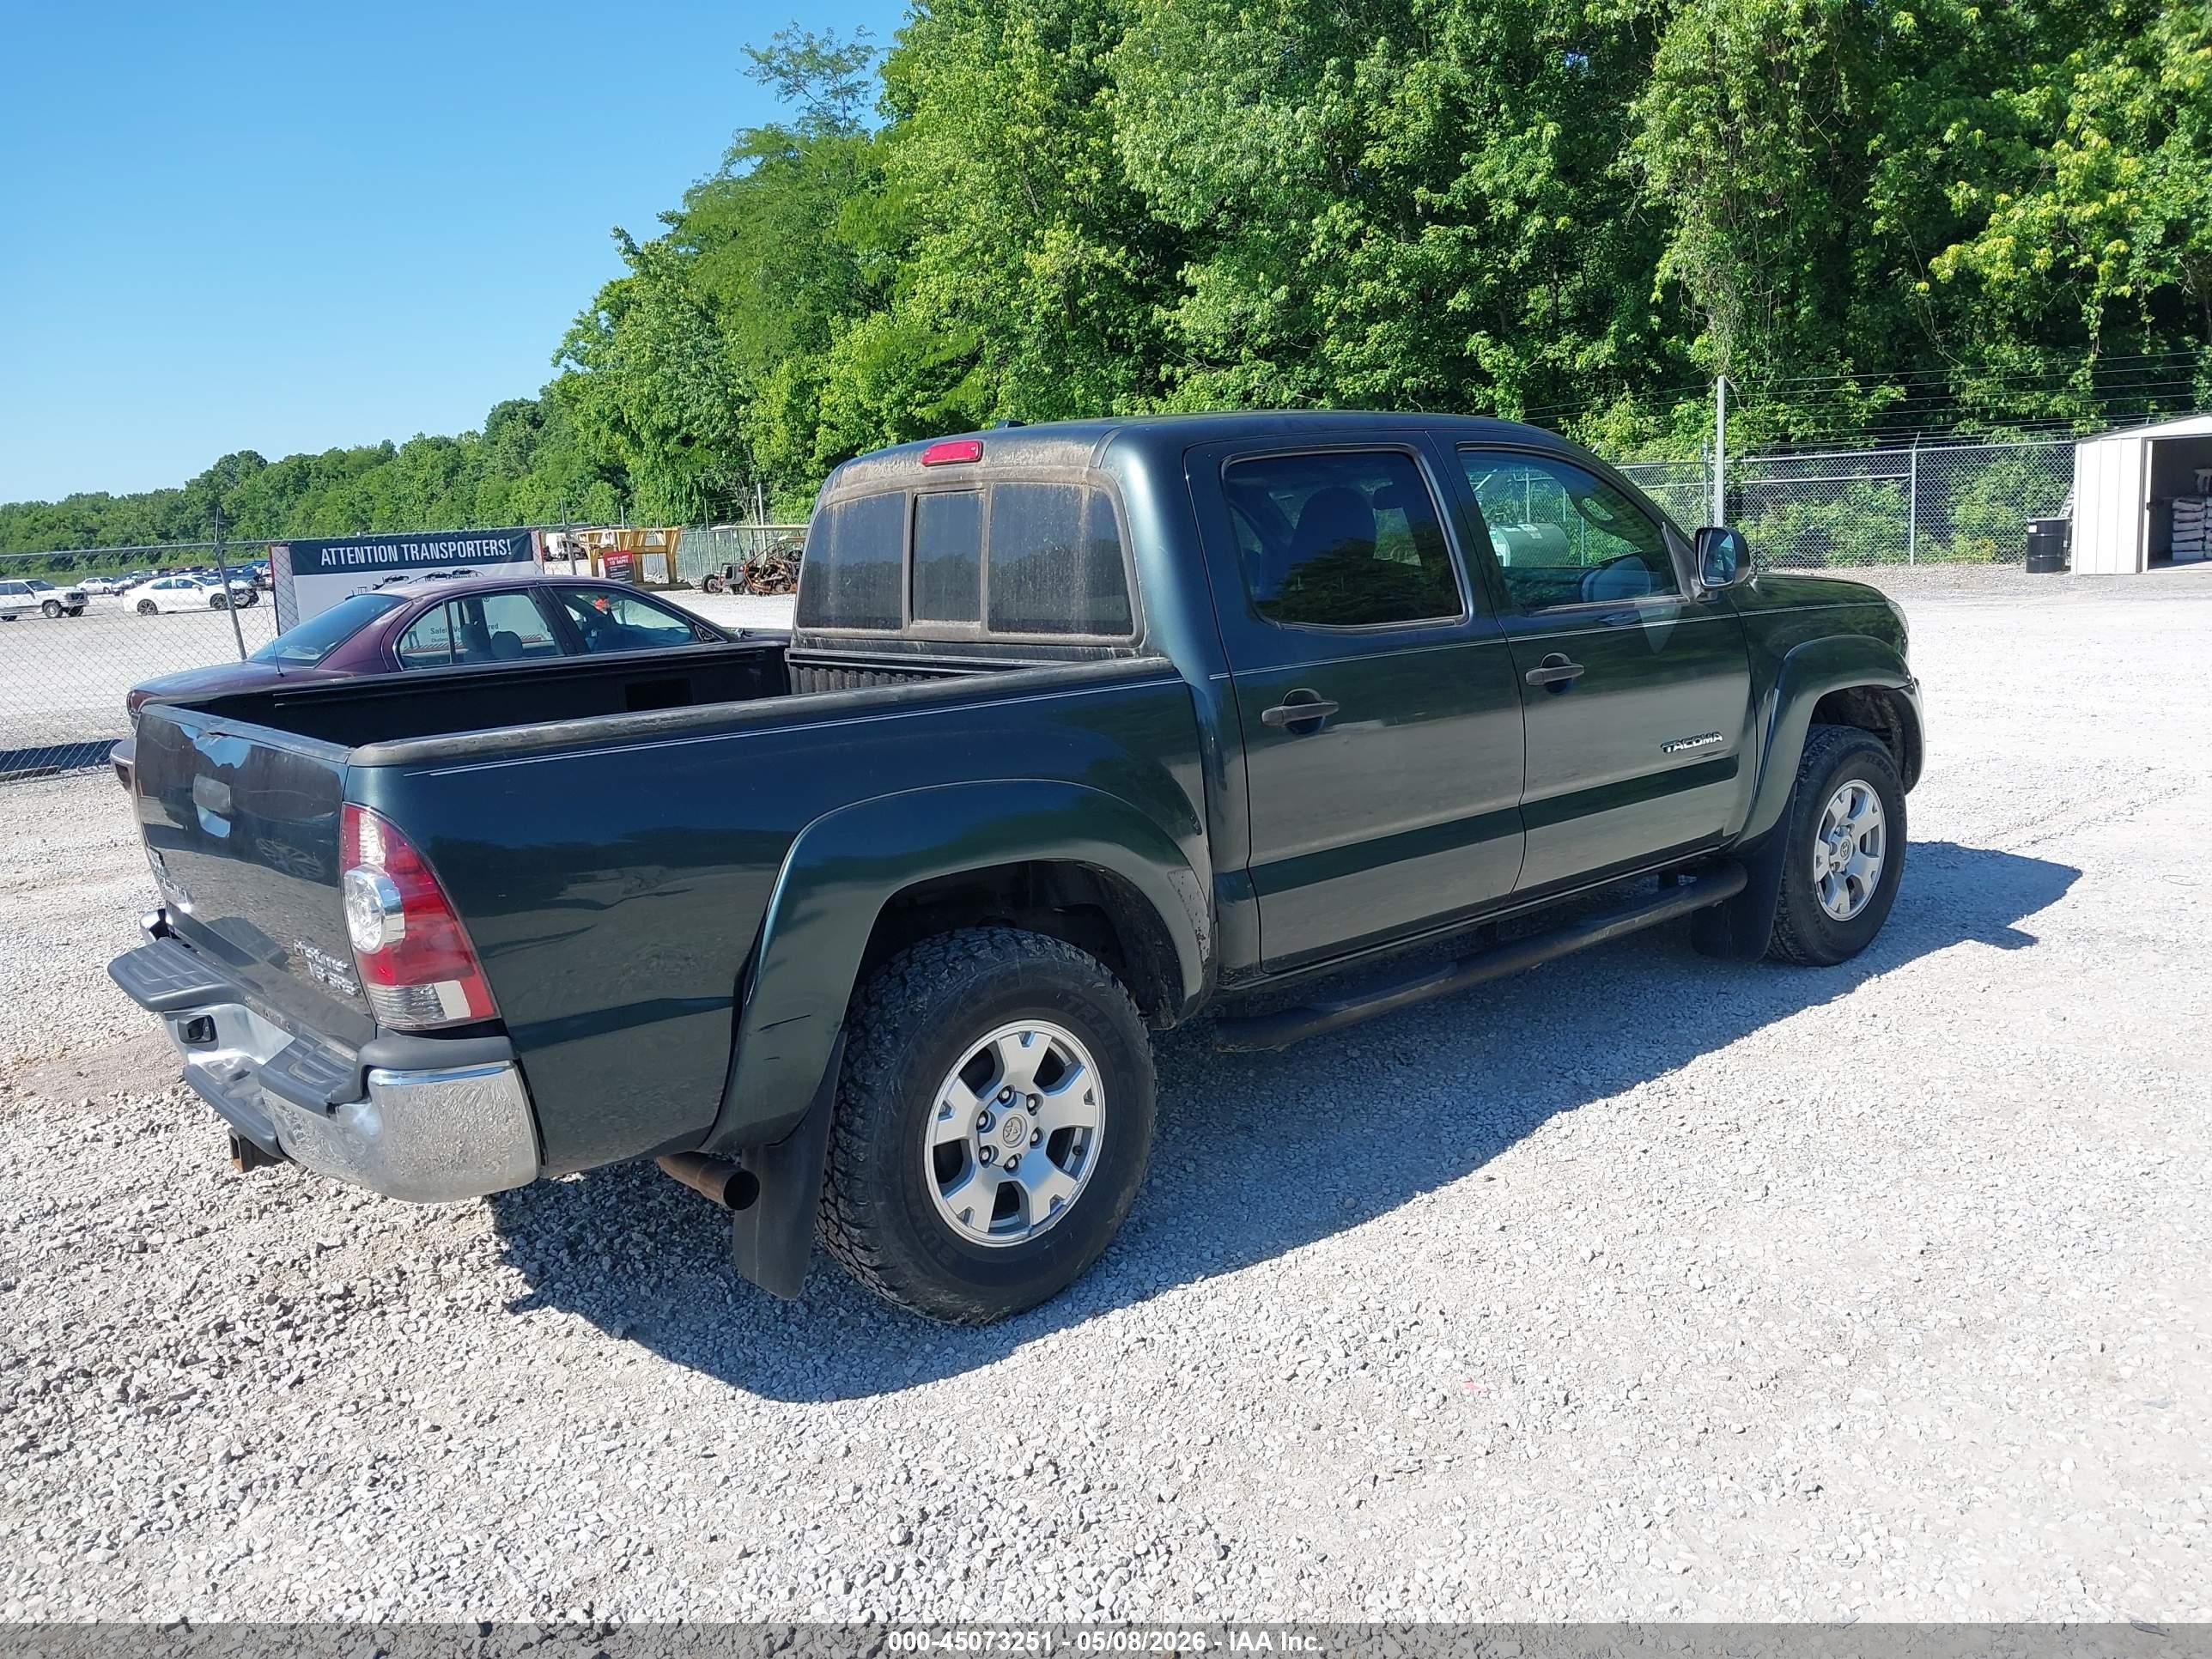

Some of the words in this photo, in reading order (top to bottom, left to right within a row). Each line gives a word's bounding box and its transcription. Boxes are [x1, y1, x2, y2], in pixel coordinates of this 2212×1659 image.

[321, 545, 398, 566] ATTENTION
[401, 538, 512, 562] TRANSPORTERS!
[1661, 732, 1723, 753] TACOMA
